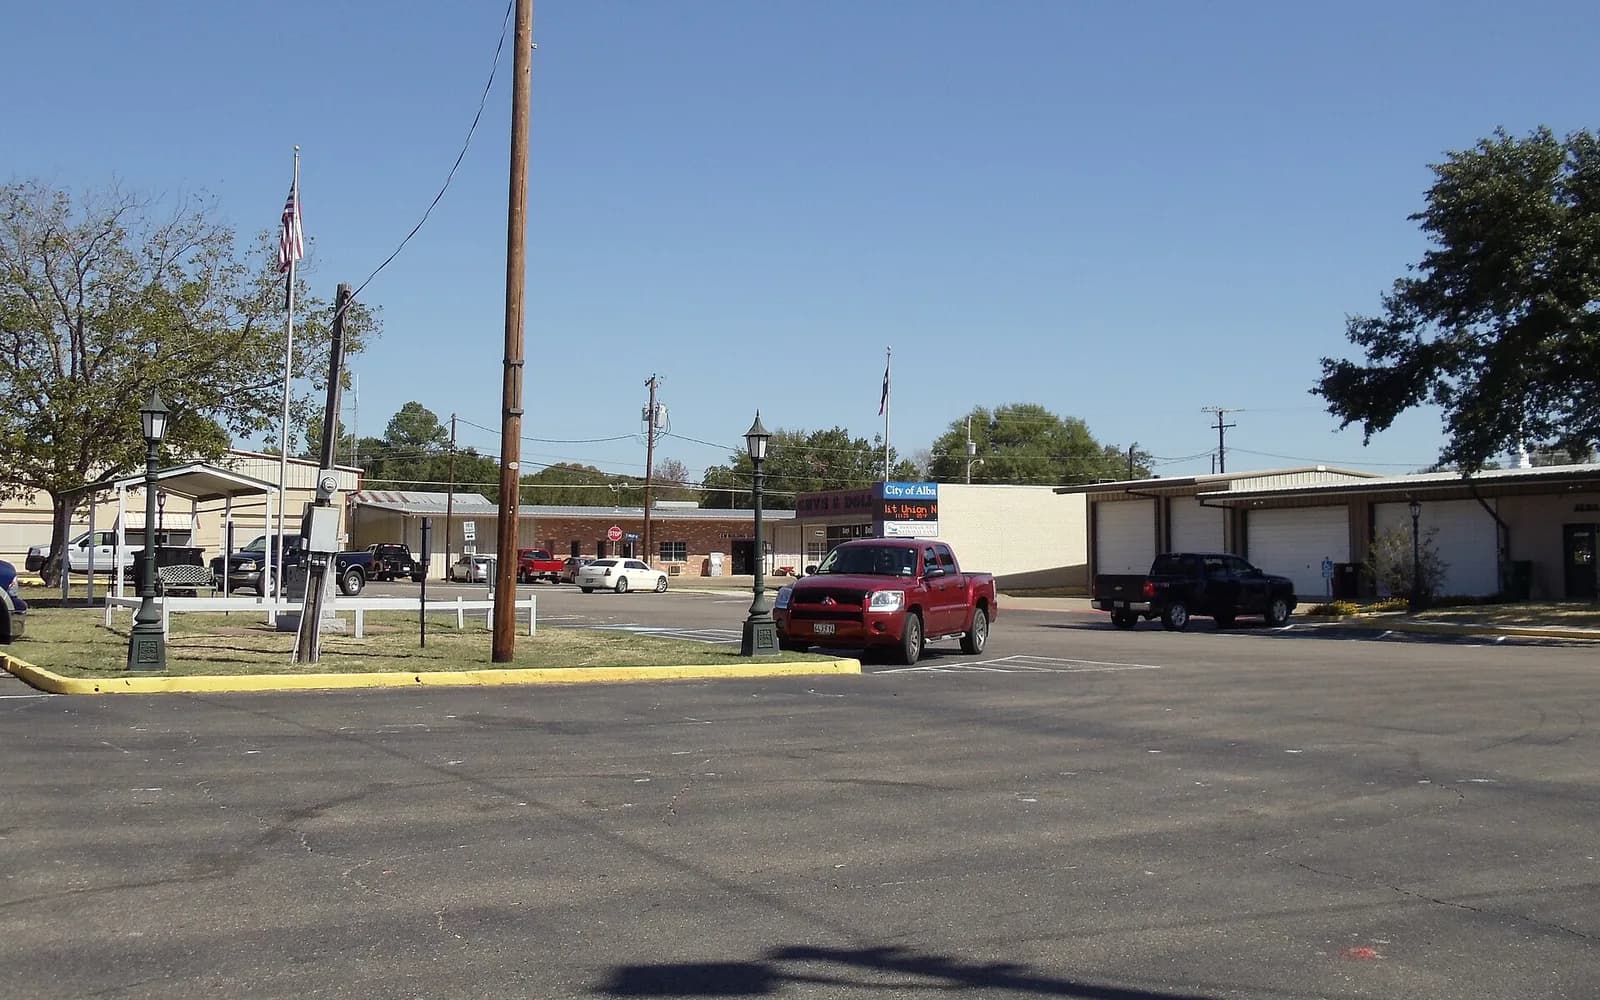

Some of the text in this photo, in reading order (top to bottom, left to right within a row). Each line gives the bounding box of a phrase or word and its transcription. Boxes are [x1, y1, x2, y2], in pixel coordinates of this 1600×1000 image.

[885, 485, 936, 496] City of Alba
[901, 504, 927, 514] Union
